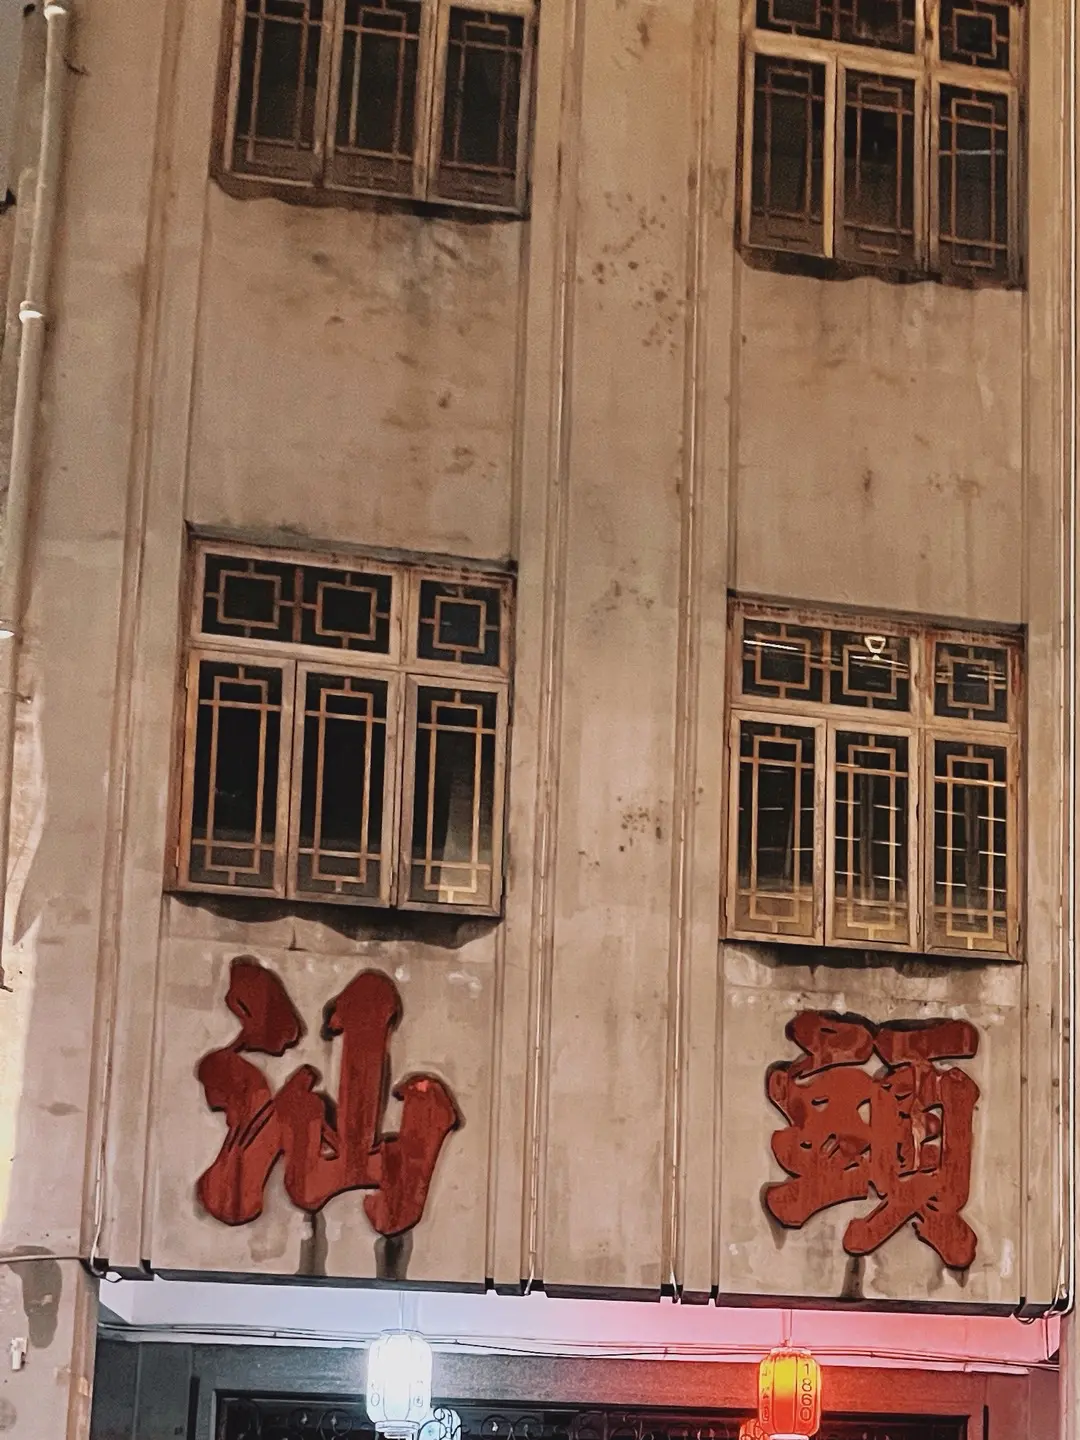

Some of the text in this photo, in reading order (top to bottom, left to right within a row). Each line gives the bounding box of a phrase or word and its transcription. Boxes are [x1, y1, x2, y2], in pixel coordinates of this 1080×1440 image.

[197, 955, 462, 1236] 汕
[764, 1009, 981, 1270] 頭
[800, 1363, 812, 1421] 1860
